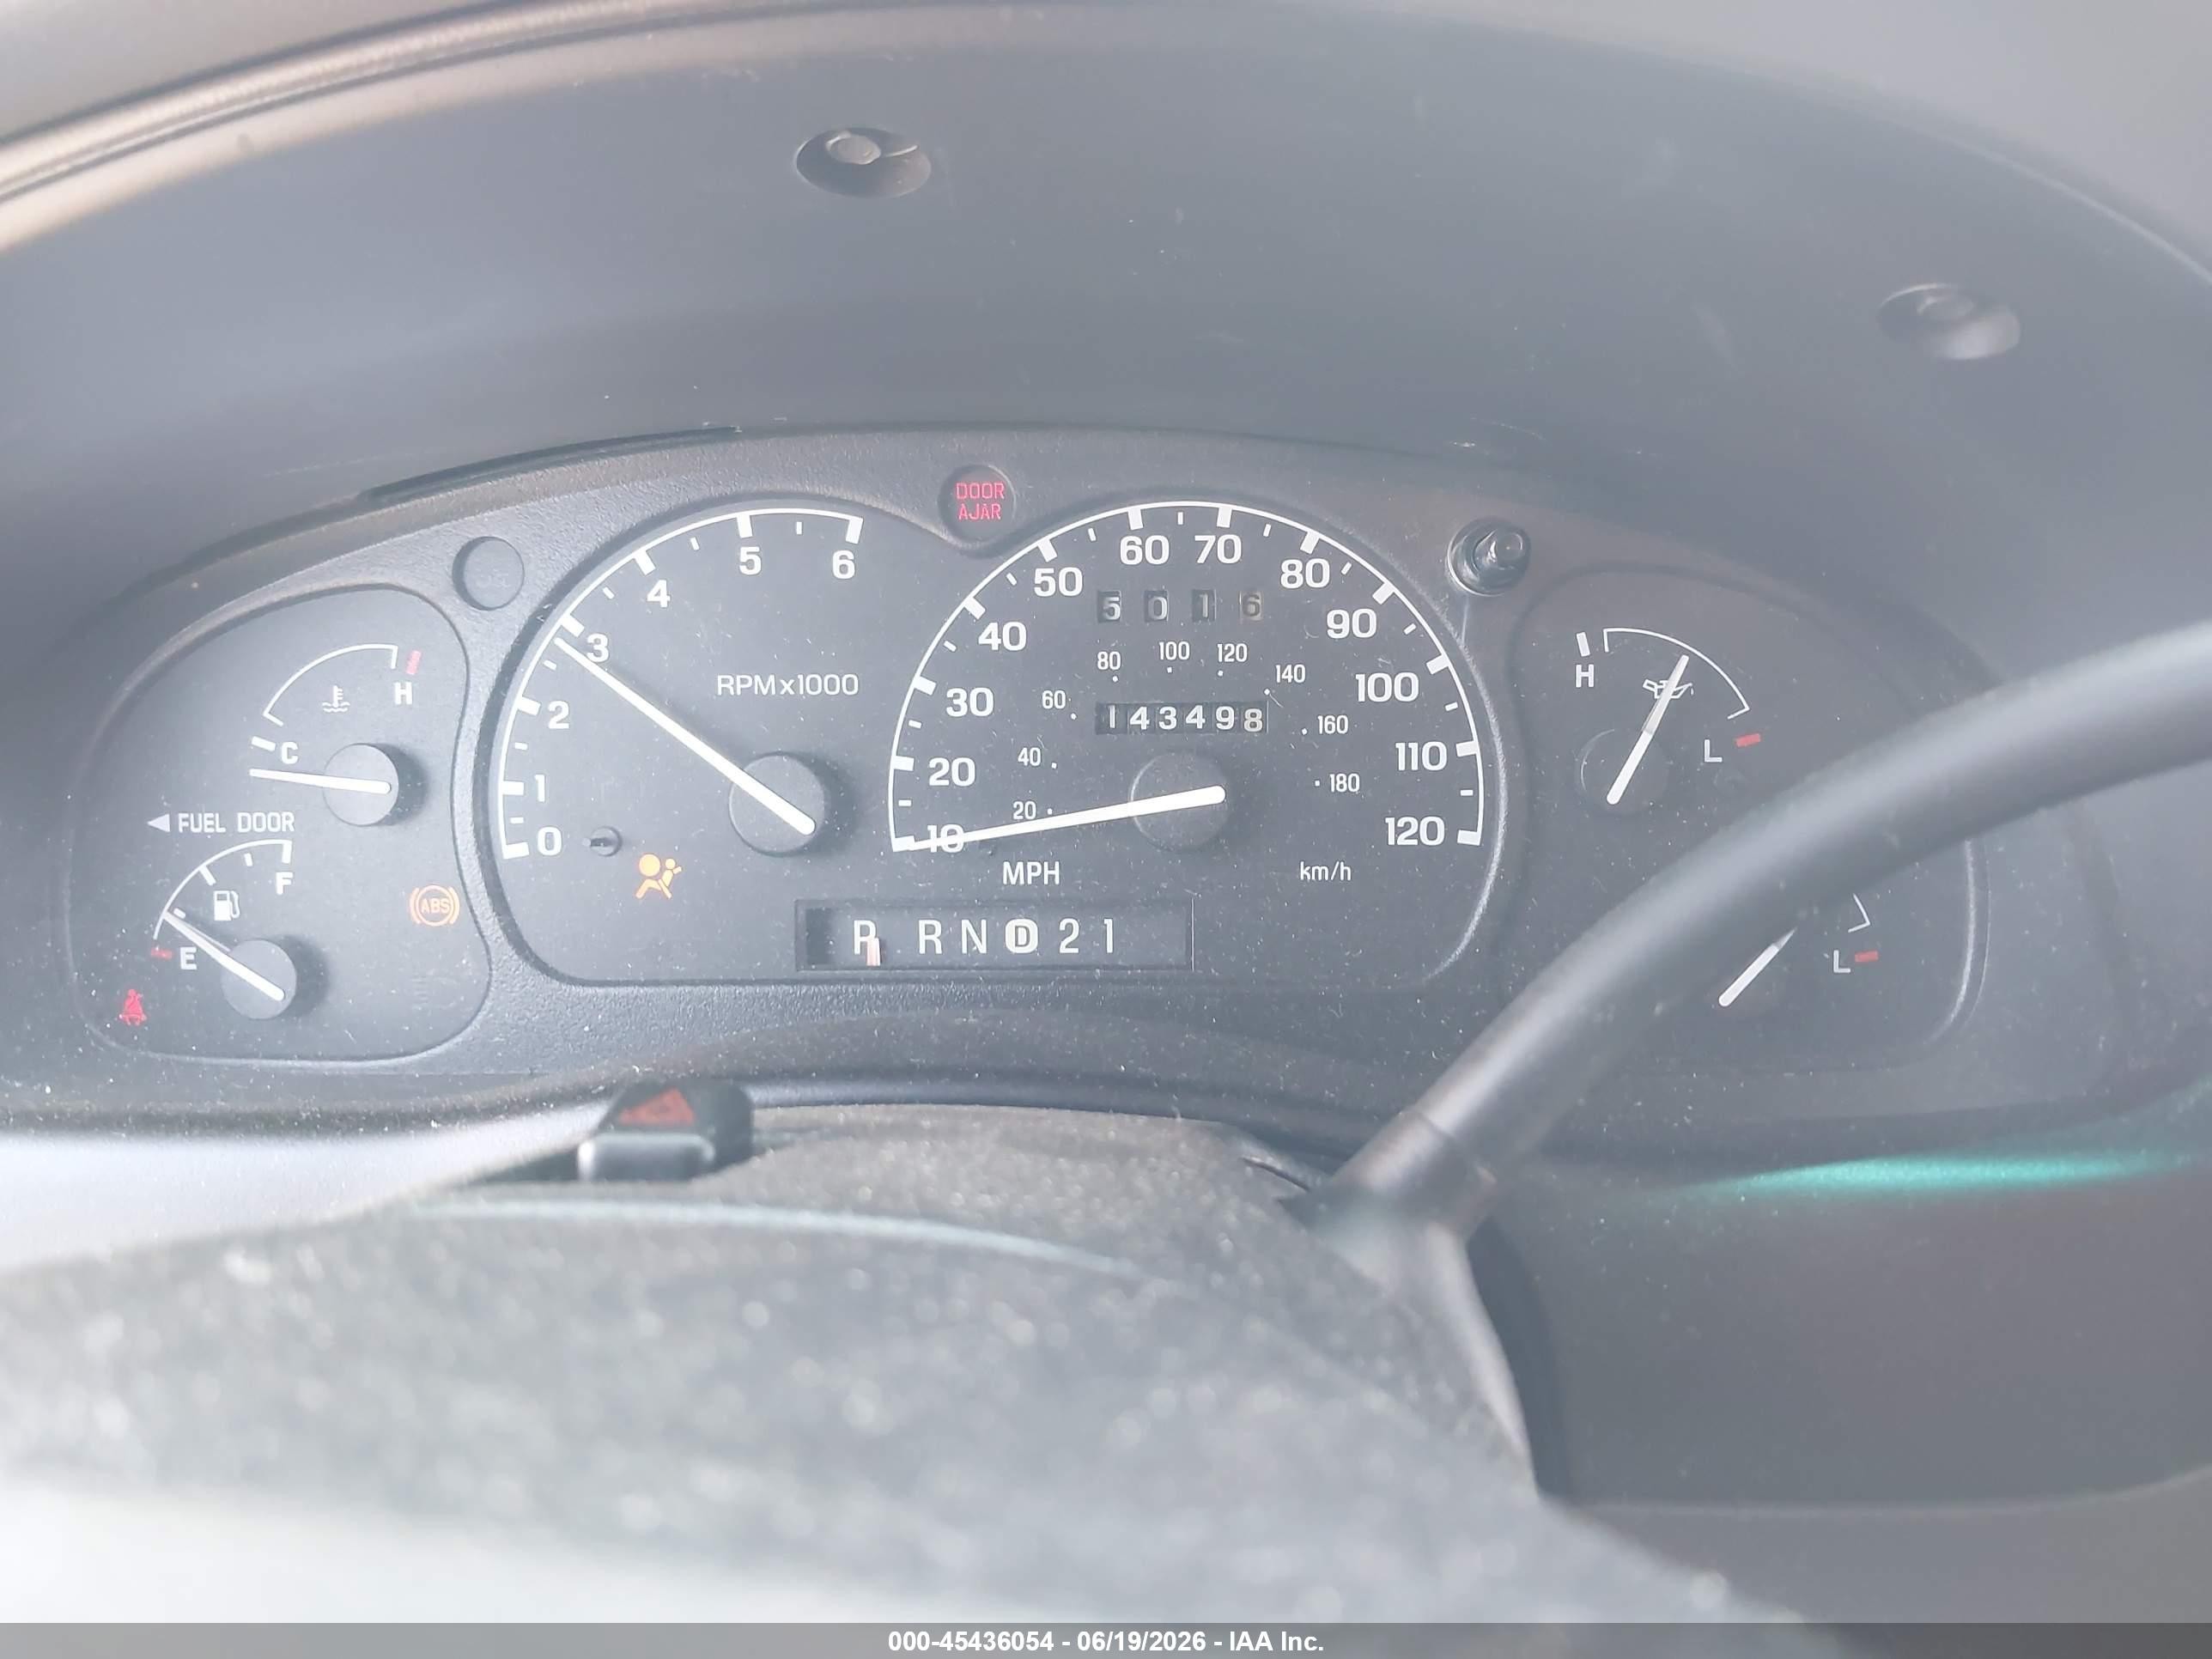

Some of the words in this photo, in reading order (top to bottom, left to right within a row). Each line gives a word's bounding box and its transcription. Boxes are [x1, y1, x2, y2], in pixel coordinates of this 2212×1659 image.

[956, 482, 1004, 499] DOOR
[958, 502, 1001, 520] AJAR
[738, 546, 762, 574] 5
[1120, 535, 1170, 565] 60
[1194, 534, 1242, 564] 70
[832, 550, 855, 580] 6
[1280, 557, 1330, 589] 80
[647, 580, 671, 607] 4
[1034, 567, 1084, 598] 50
[1326, 608, 1377, 639] 90
[586, 633, 610, 661] 3
[978, 621, 1027, 653] 40
[1097, 651, 1121, 670] 80
[1159, 641, 1190, 660] 100
[1217, 643, 1248, 662] 120
[1275, 664, 1306, 684] 140
[1355, 672, 1420, 702] 100
[1575, 664, 1595, 688] H
[393, 682, 413, 705] H
[945, 688, 995, 718] 30
[1042, 690, 1066, 710] 60
[548, 701, 570, 730] 2
[1107, 704, 1264, 732] 143498
[1317, 715, 1349, 734] 160
[280, 740, 299, 764] C
[1017, 747, 1042, 767] 40
[1395, 741, 1448, 771] 110
[1704, 738, 1723, 763] L
[928, 756, 976, 787] 20
[1328, 773, 1361, 793] 180
[534, 774, 546, 803] 1
[177, 812, 227, 833] FUEL
[236, 812, 295, 833] DOOR
[1012, 800, 1037, 820] 20
[537, 827, 562, 855] 0
[927, 823, 964, 853] 10
[1384, 816, 1446, 847] 120
[276, 871, 294, 896] F
[1002, 860, 1061, 886] MPH
[1299, 861, 1352, 882] km/h
[420, 897, 451, 915] ABS
[918, 918, 944, 955] R
[960, 918, 988, 955] N
[1058, 918, 1081, 954] 2
[1103, 918, 1115, 954] 1
[179, 946, 198, 970] E
[1832, 949, 1852, 974] L
